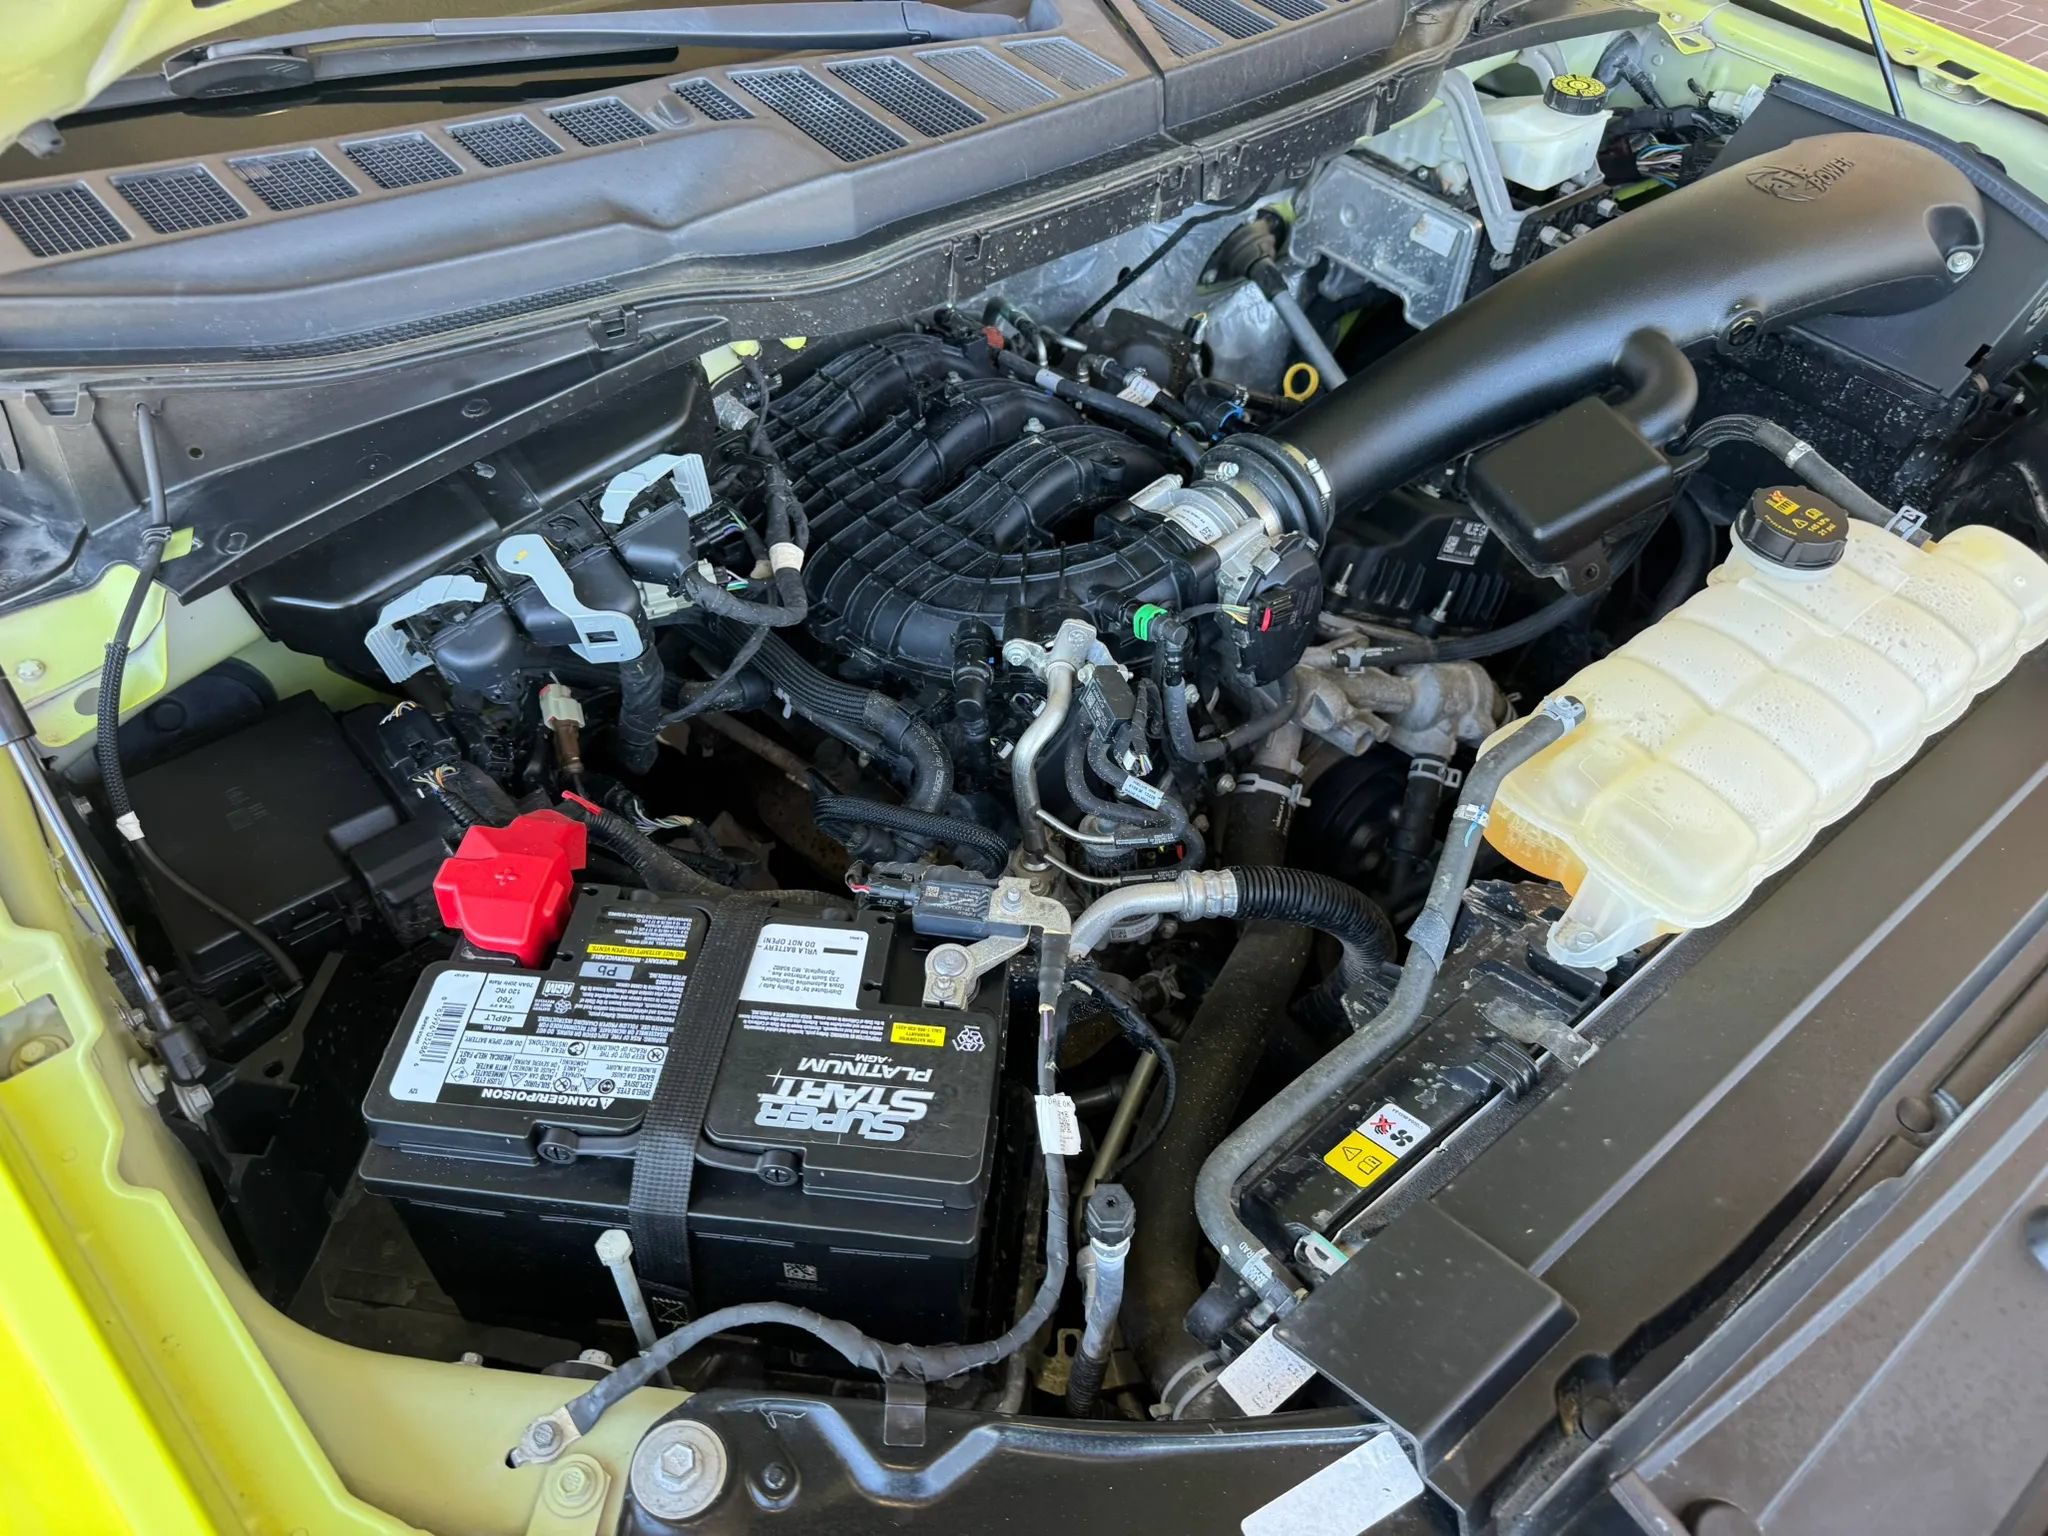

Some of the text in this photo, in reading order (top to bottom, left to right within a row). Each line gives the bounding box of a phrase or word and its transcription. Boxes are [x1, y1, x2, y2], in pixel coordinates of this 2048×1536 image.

[762, 936, 785, 944] OPEN!
[763, 944, 796, 952] BATTERY
[644, 957, 678, 965] IMPORTANT
[597, 965, 617, 976] Pb
[796, 979, 827, 987] Automotive
[544, 982, 571, 994] AGM
[810, 987, 841, 995] Distributed
[496, 995, 512, 1003] 760
[484, 1013, 512, 1022] 48PLT
[489, 1053, 511, 1061] MEDICAL
[855, 1053, 887, 1063] AGM
[471, 1069, 505, 1077] IMMEDIATELY
[796, 1056, 933, 1083] PLATINUM
[523, 1080, 550, 1088] SULFURIC
[631, 1088, 650, 1096] SHIELD
[481, 1088, 598, 1106] DANGER/POISON
[757, 1075, 934, 1121] START
[753, 1100, 909, 1143] SUPER
[1237, 1240, 1255, 1258] RAD
